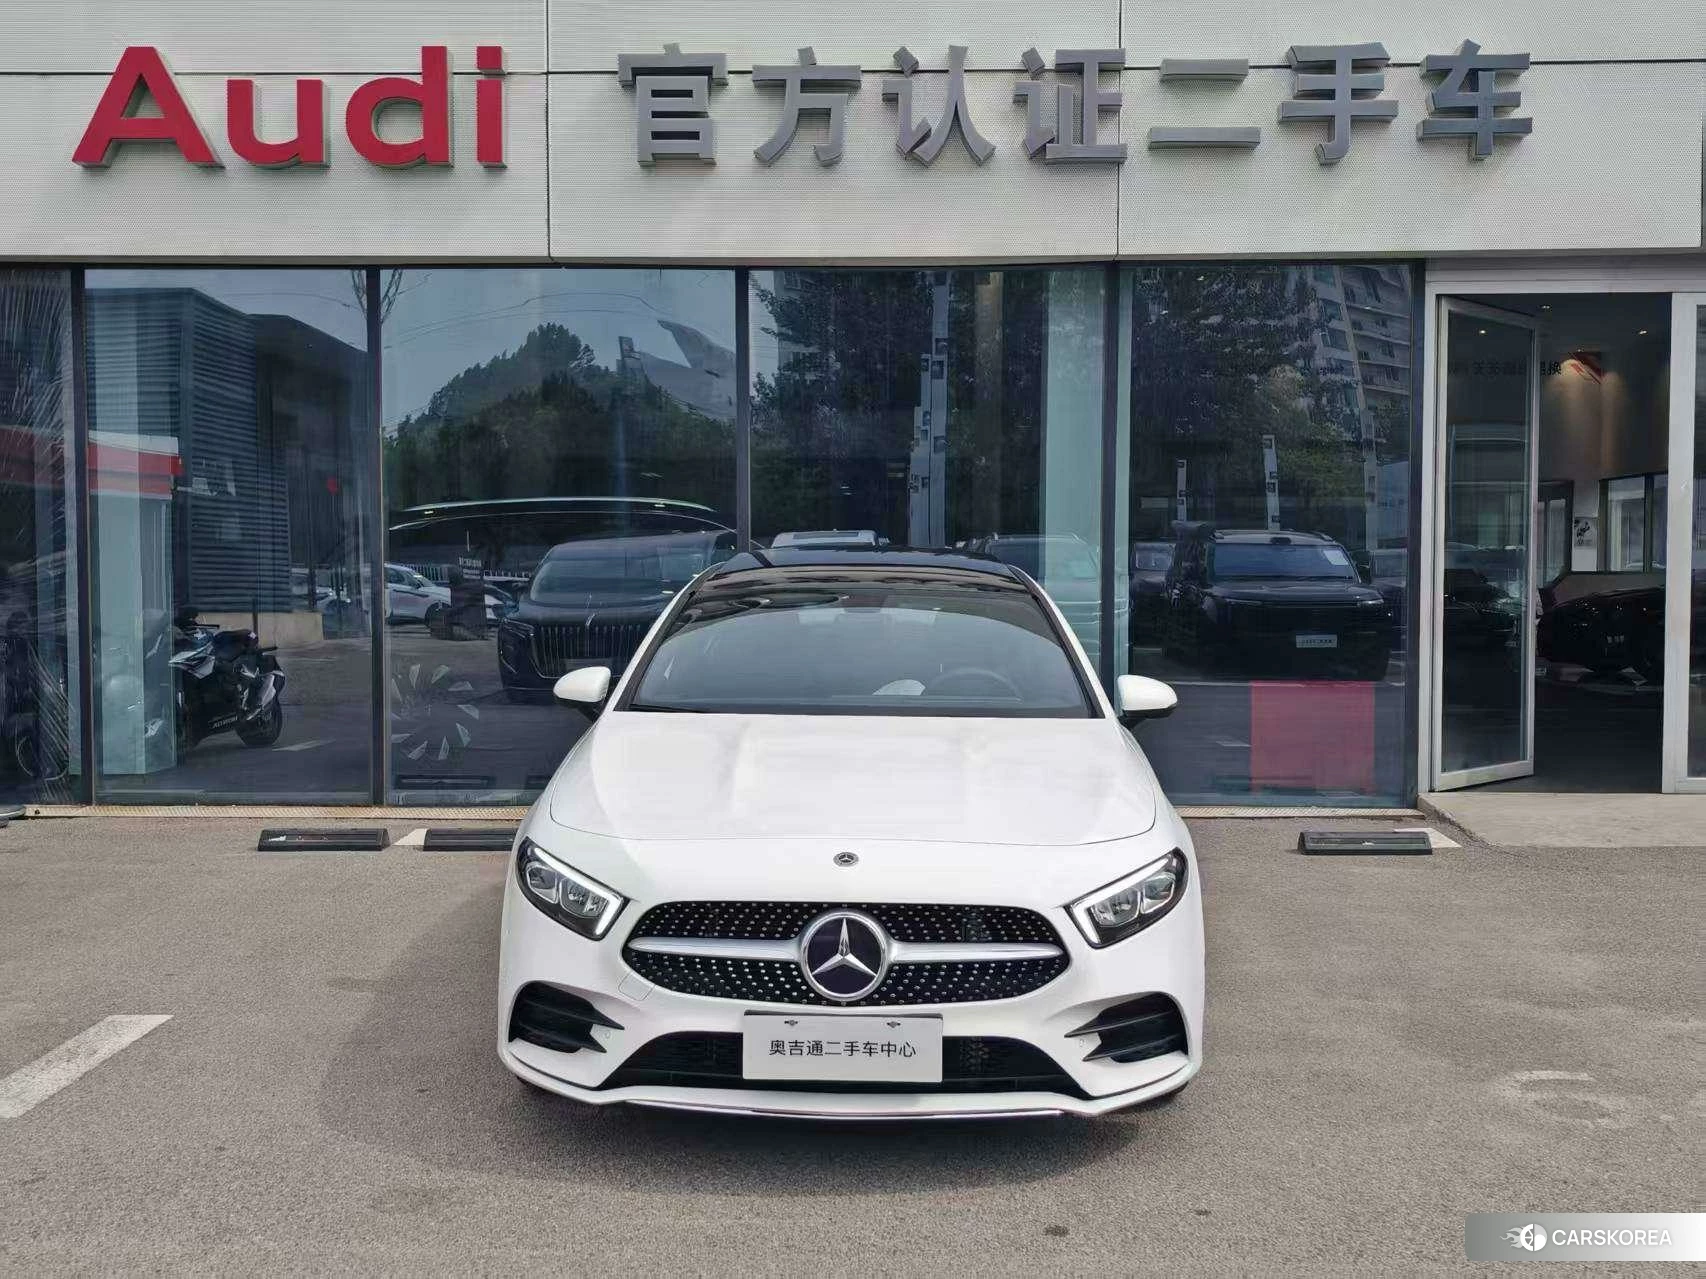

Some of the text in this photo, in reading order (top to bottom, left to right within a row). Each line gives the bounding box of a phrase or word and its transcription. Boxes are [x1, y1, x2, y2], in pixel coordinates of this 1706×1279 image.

[72, 39, 1533, 170] Audi 官方认证二手车
[768, 1039, 917, 1058] 奥吉通二手车中心
